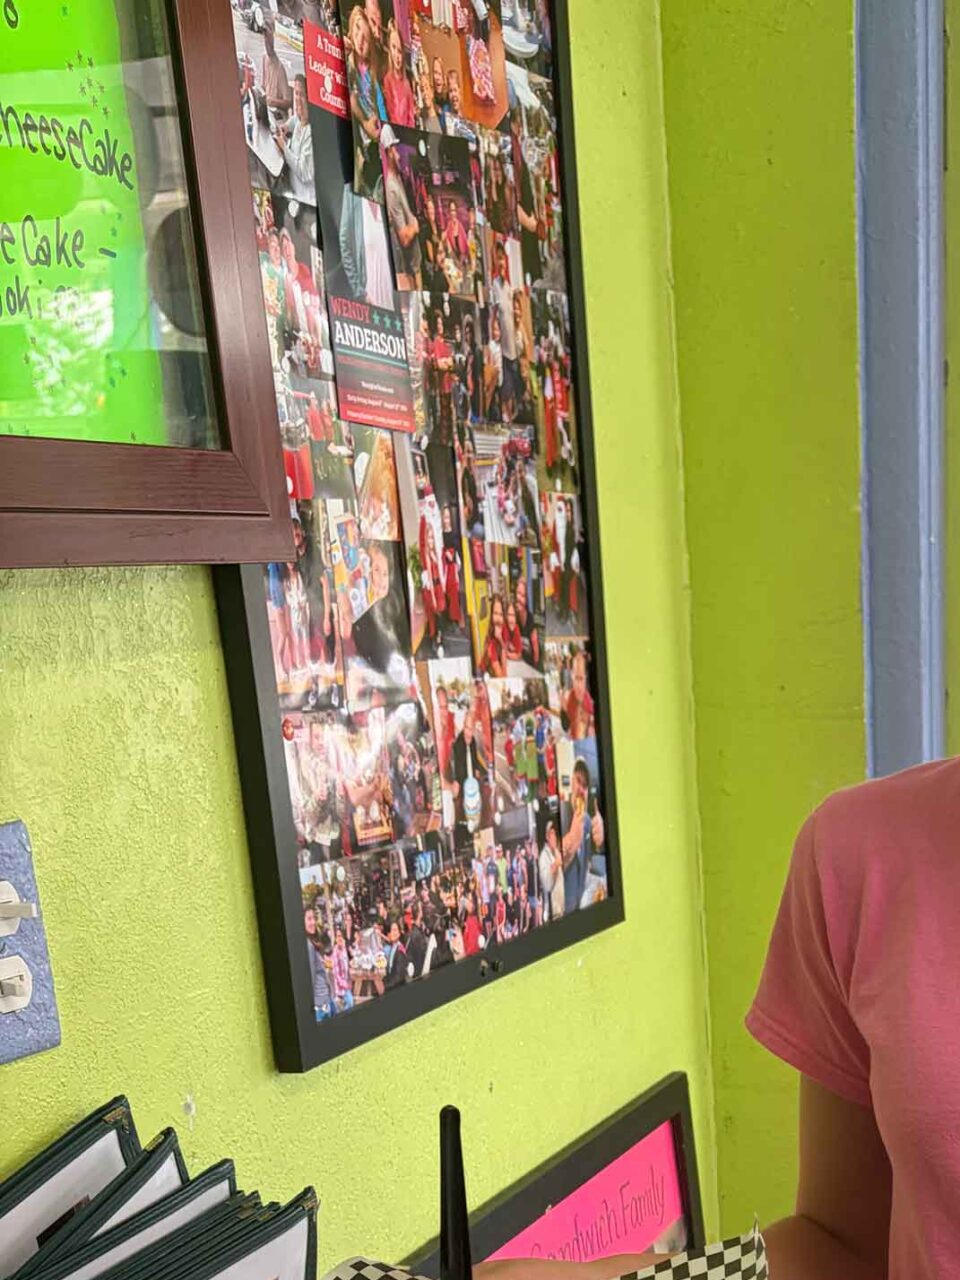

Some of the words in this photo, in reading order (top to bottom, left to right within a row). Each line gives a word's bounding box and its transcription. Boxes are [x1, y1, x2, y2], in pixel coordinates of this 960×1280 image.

[0, 102, 134, 191] heeseCake
[21, 214, 85, 269] Cake
[329, 295, 371, 324] WENDY
[335, 320, 406, 360] ANDERSON
[619, 1163, 665, 1236] Family
